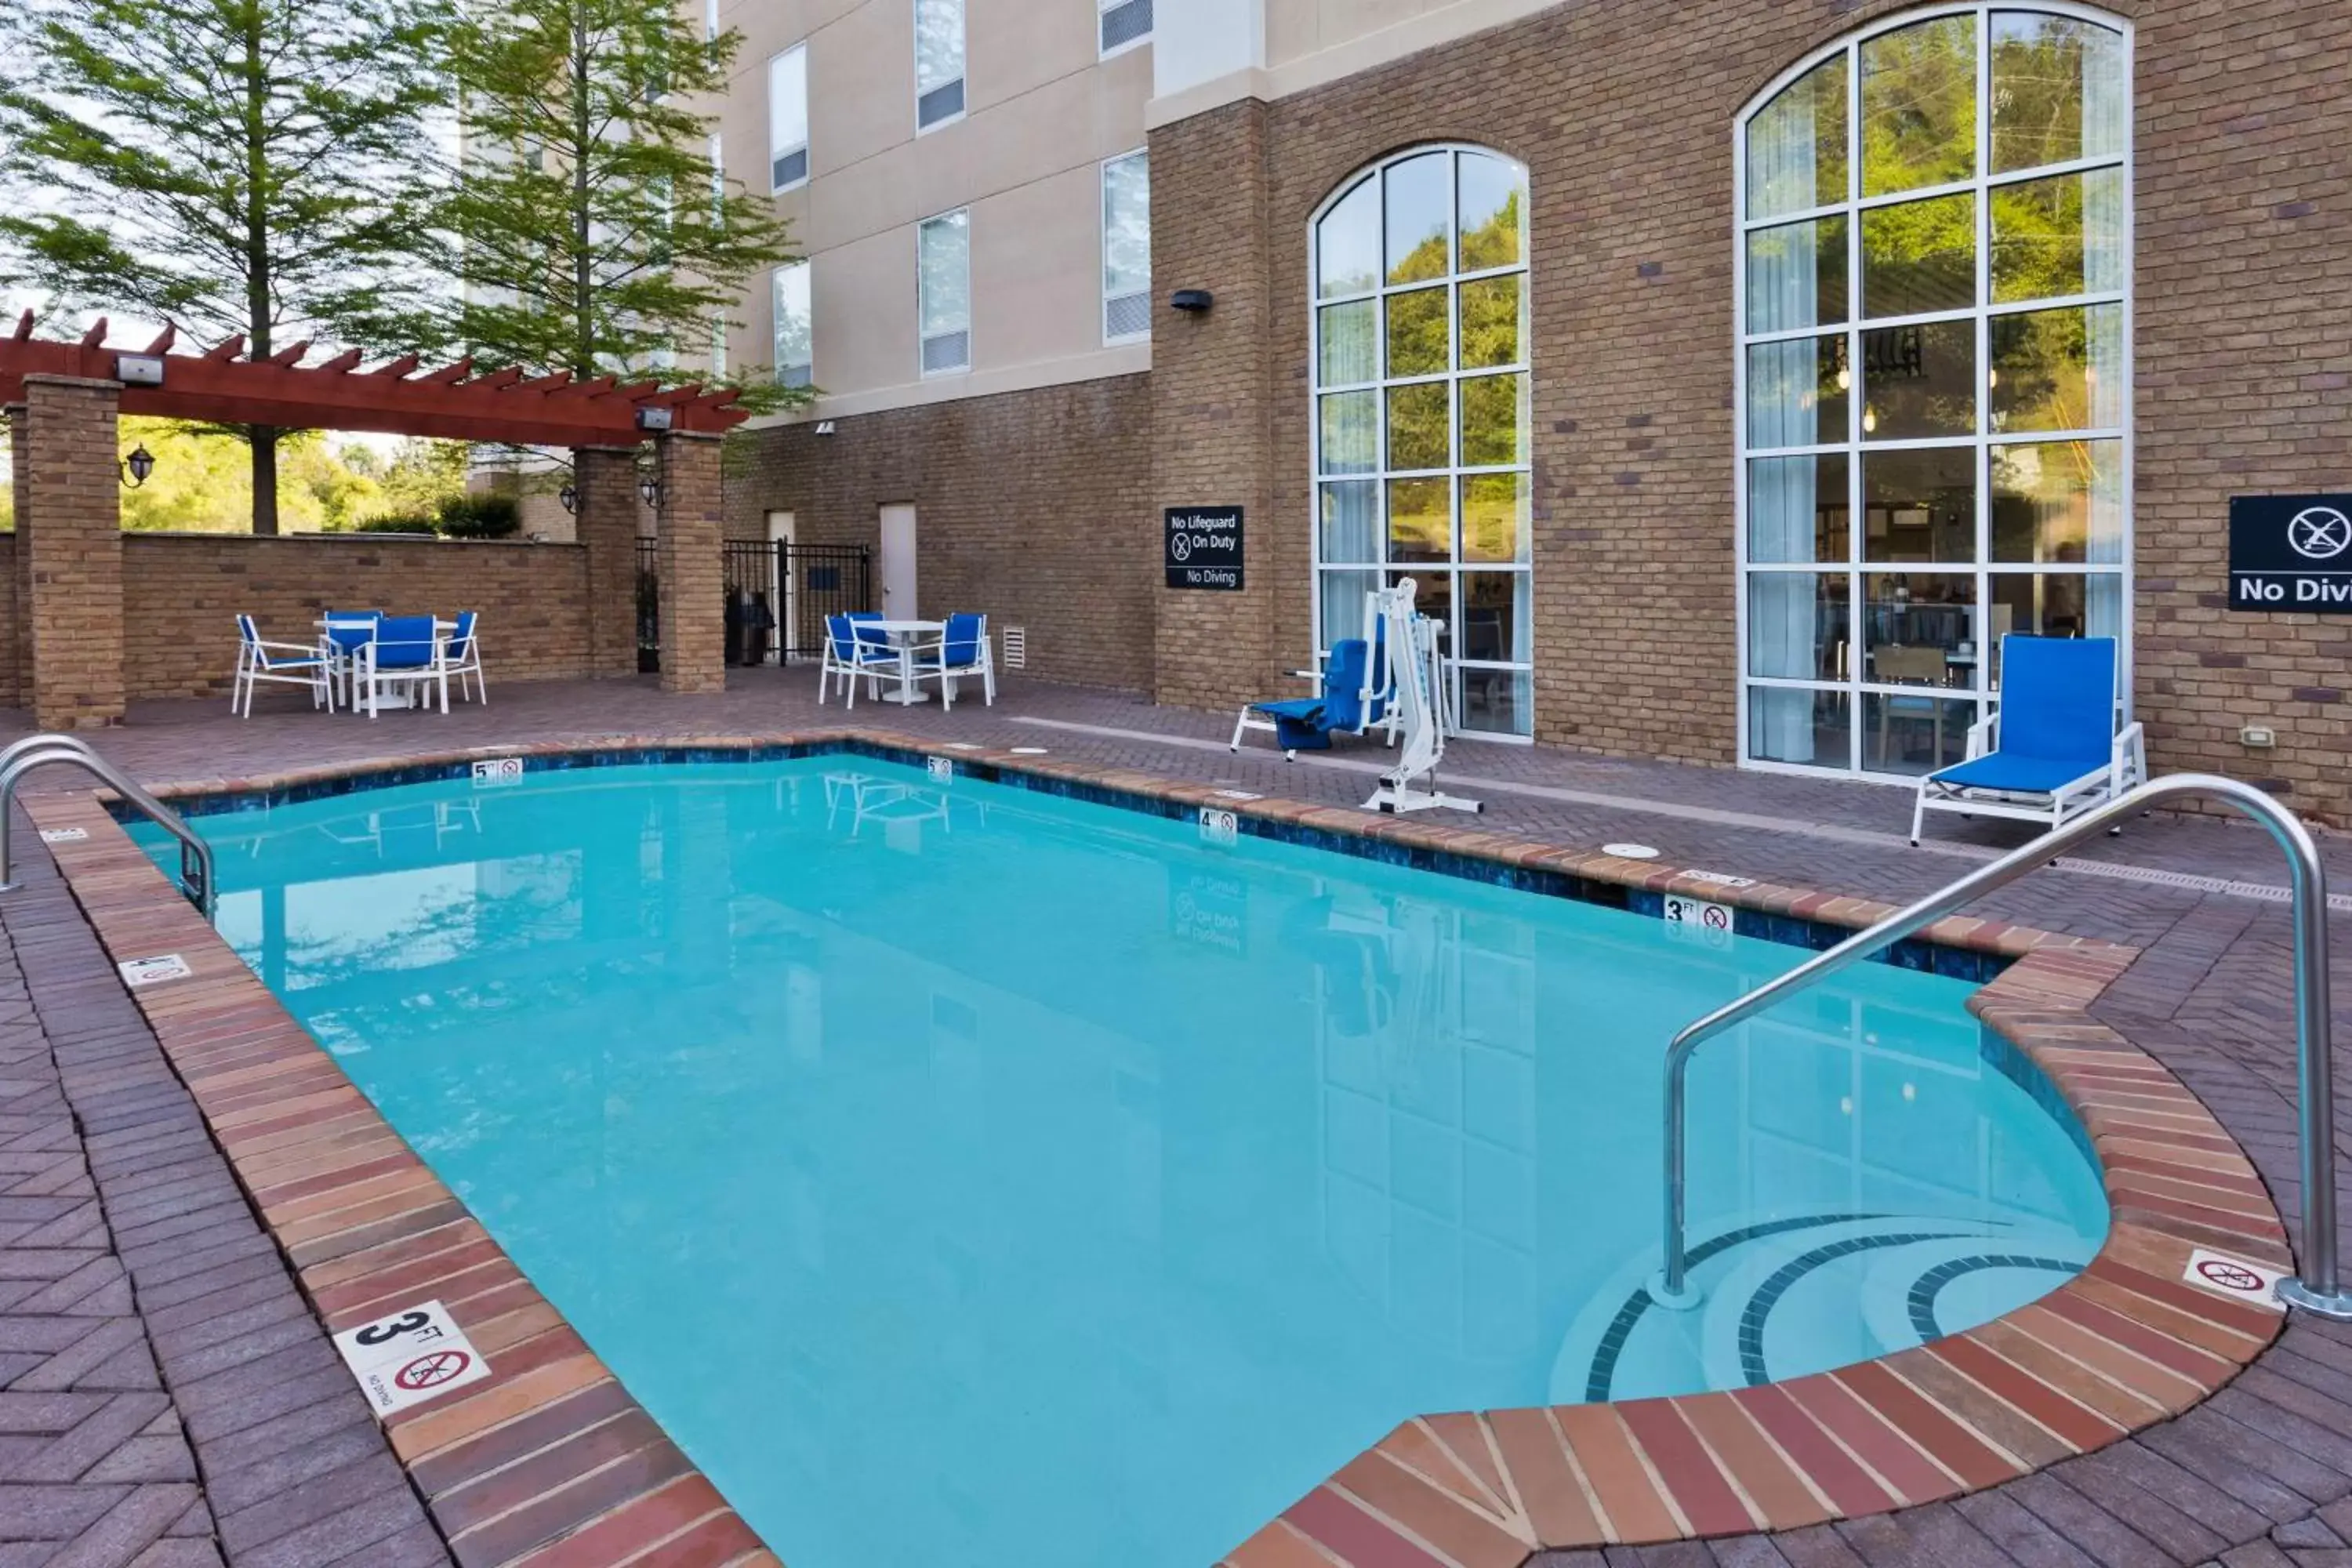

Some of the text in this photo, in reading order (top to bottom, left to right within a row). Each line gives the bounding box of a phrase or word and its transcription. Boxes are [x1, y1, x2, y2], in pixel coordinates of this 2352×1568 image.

[1171, 514, 1236, 532] No Lifeguard
[1192, 535, 1236, 551] On Duty
[1187, 569, 1236, 587] No Diving
[2240, 578, 2285, 601] No
[1668, 900, 1694, 921] 3 FT
[355, 1312, 444, 1346] 3 FT
